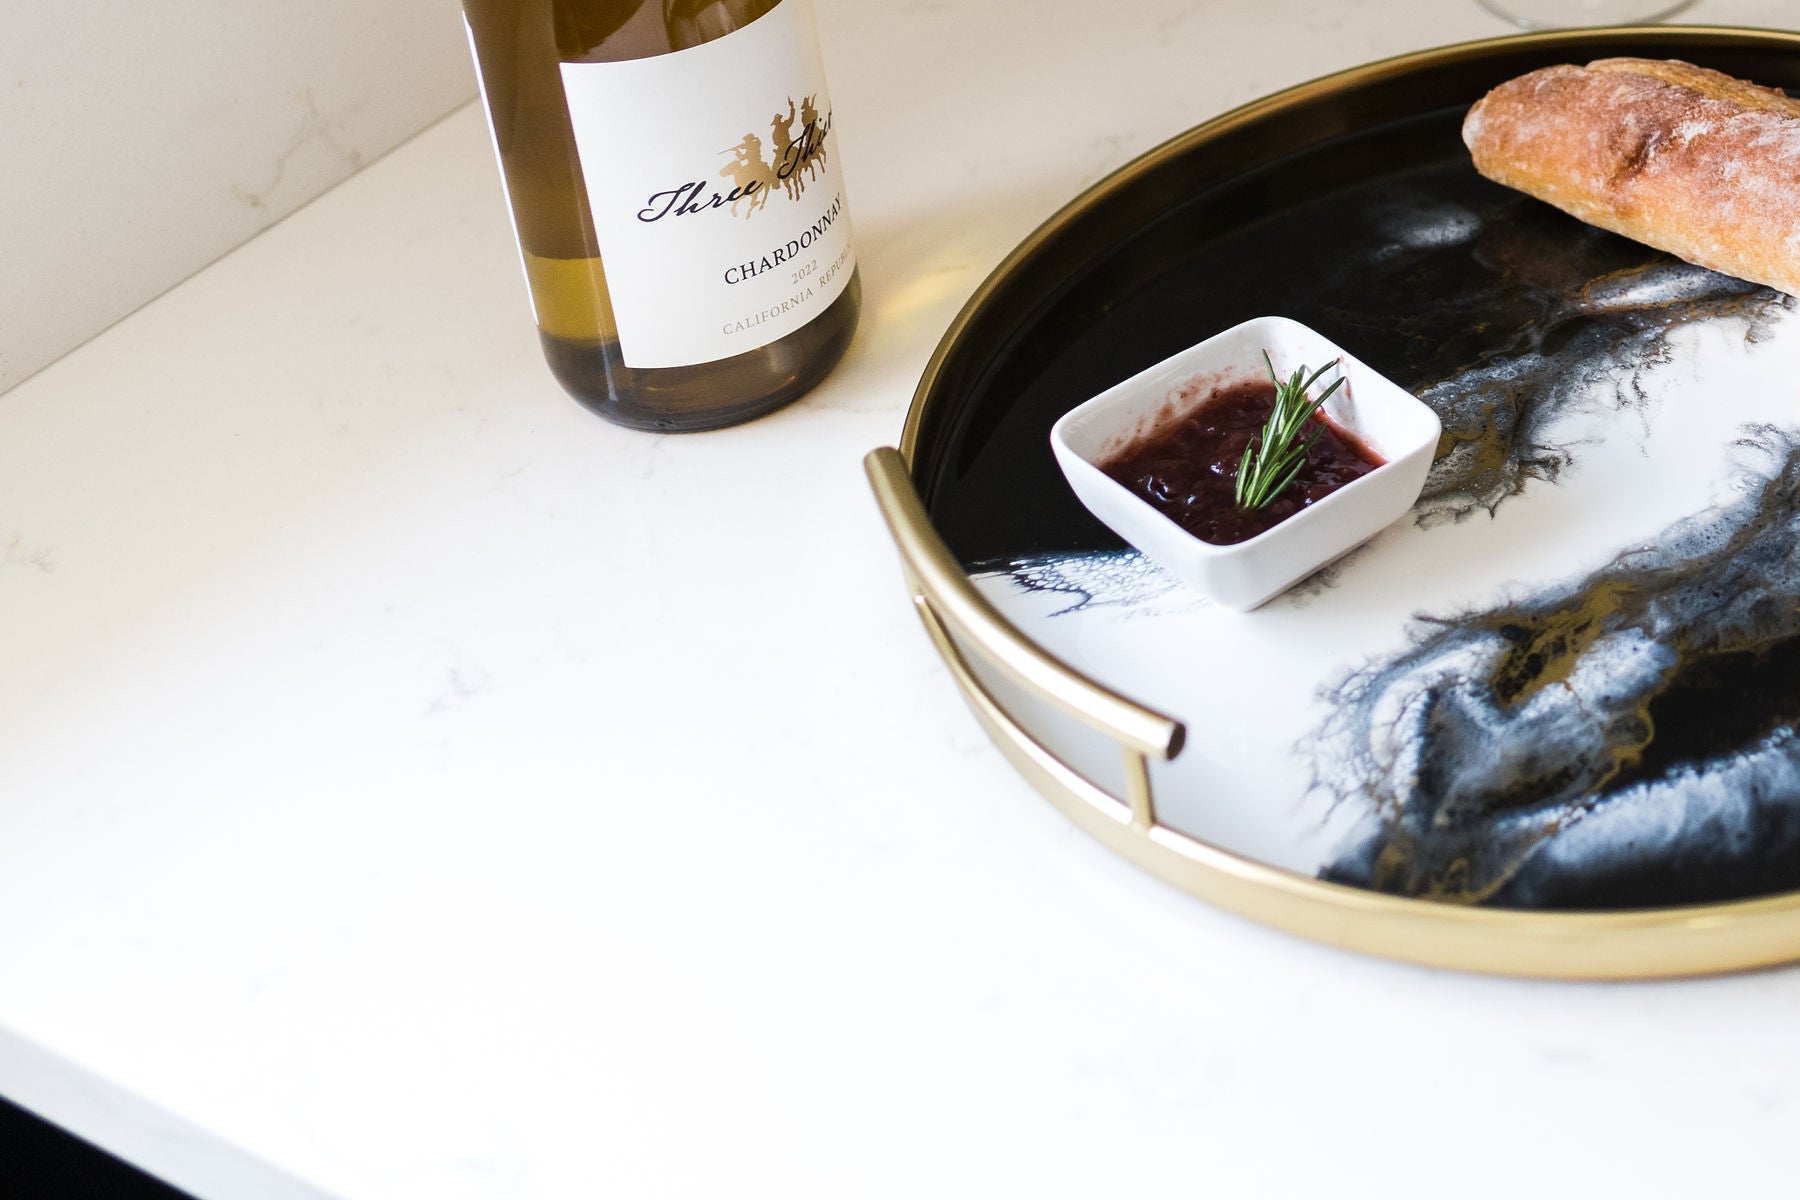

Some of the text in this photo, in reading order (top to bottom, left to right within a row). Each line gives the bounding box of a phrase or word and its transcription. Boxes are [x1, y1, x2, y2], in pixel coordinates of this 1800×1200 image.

[637, 180, 764, 223] Three
[724, 192, 842, 285] CHARDONNAY
[791, 259, 818, 285] 2022
[722, 287, 814, 335] CALIFORNIA
